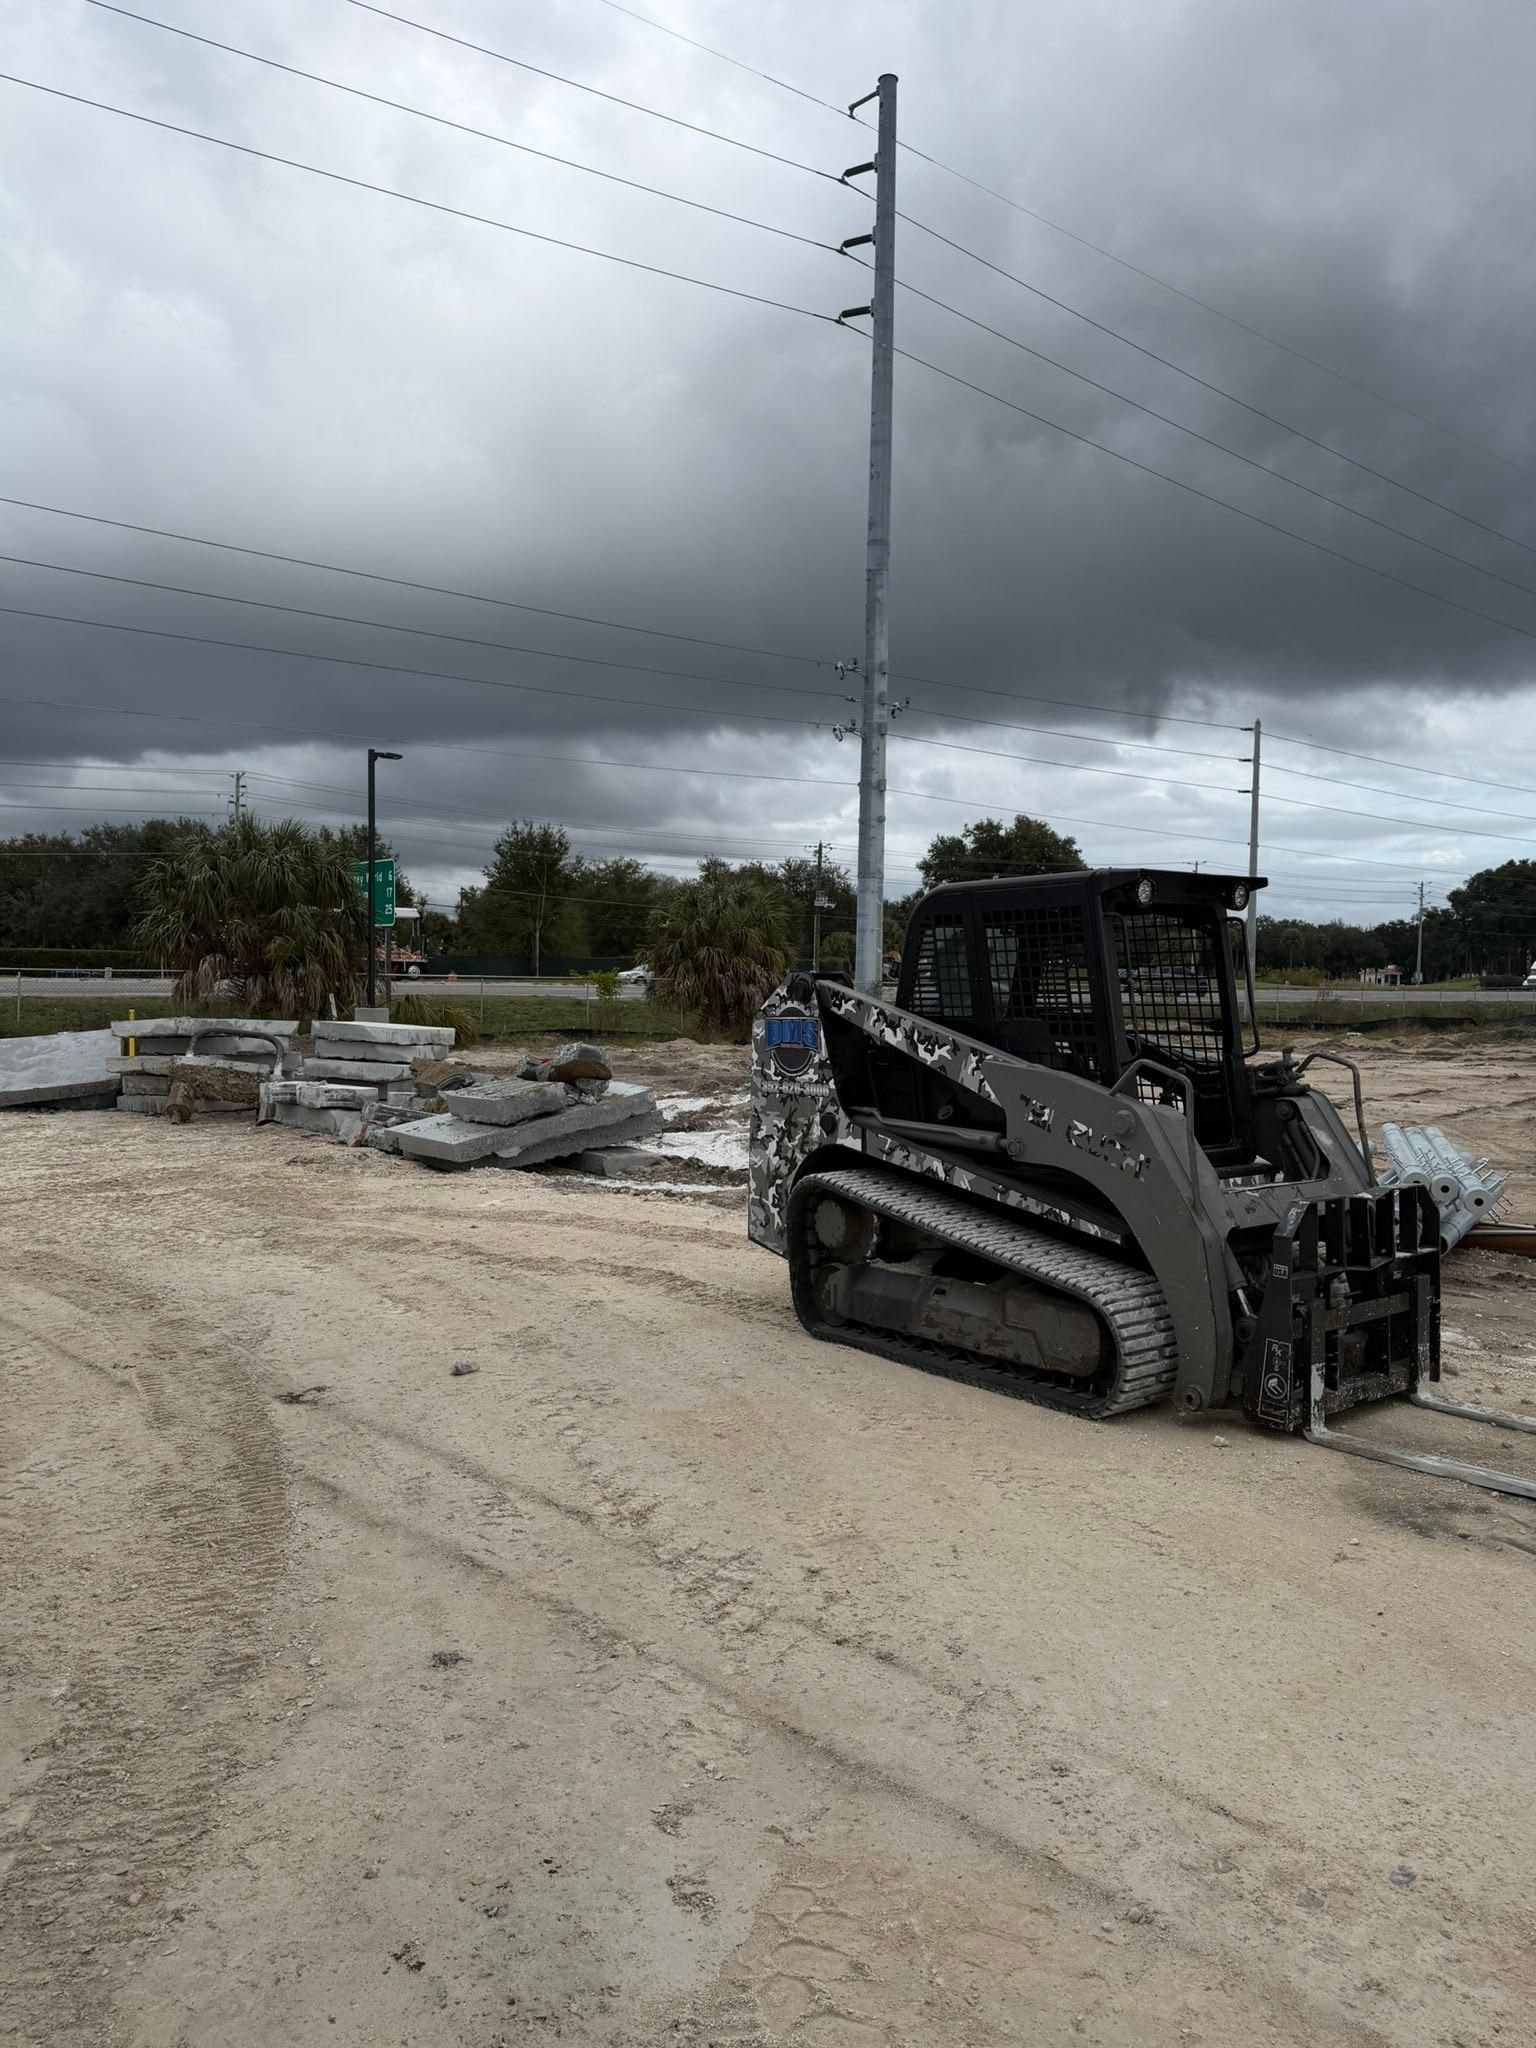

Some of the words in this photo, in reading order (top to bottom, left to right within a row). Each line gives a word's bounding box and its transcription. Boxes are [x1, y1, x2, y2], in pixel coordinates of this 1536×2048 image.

[388, 870, 393, 881] 6
[386, 887, 393, 898] 17
[385, 903, 393, 915] 25
[767, 1019, 818, 1048] DMS
[1274, 1268, 1288, 1278] USA
